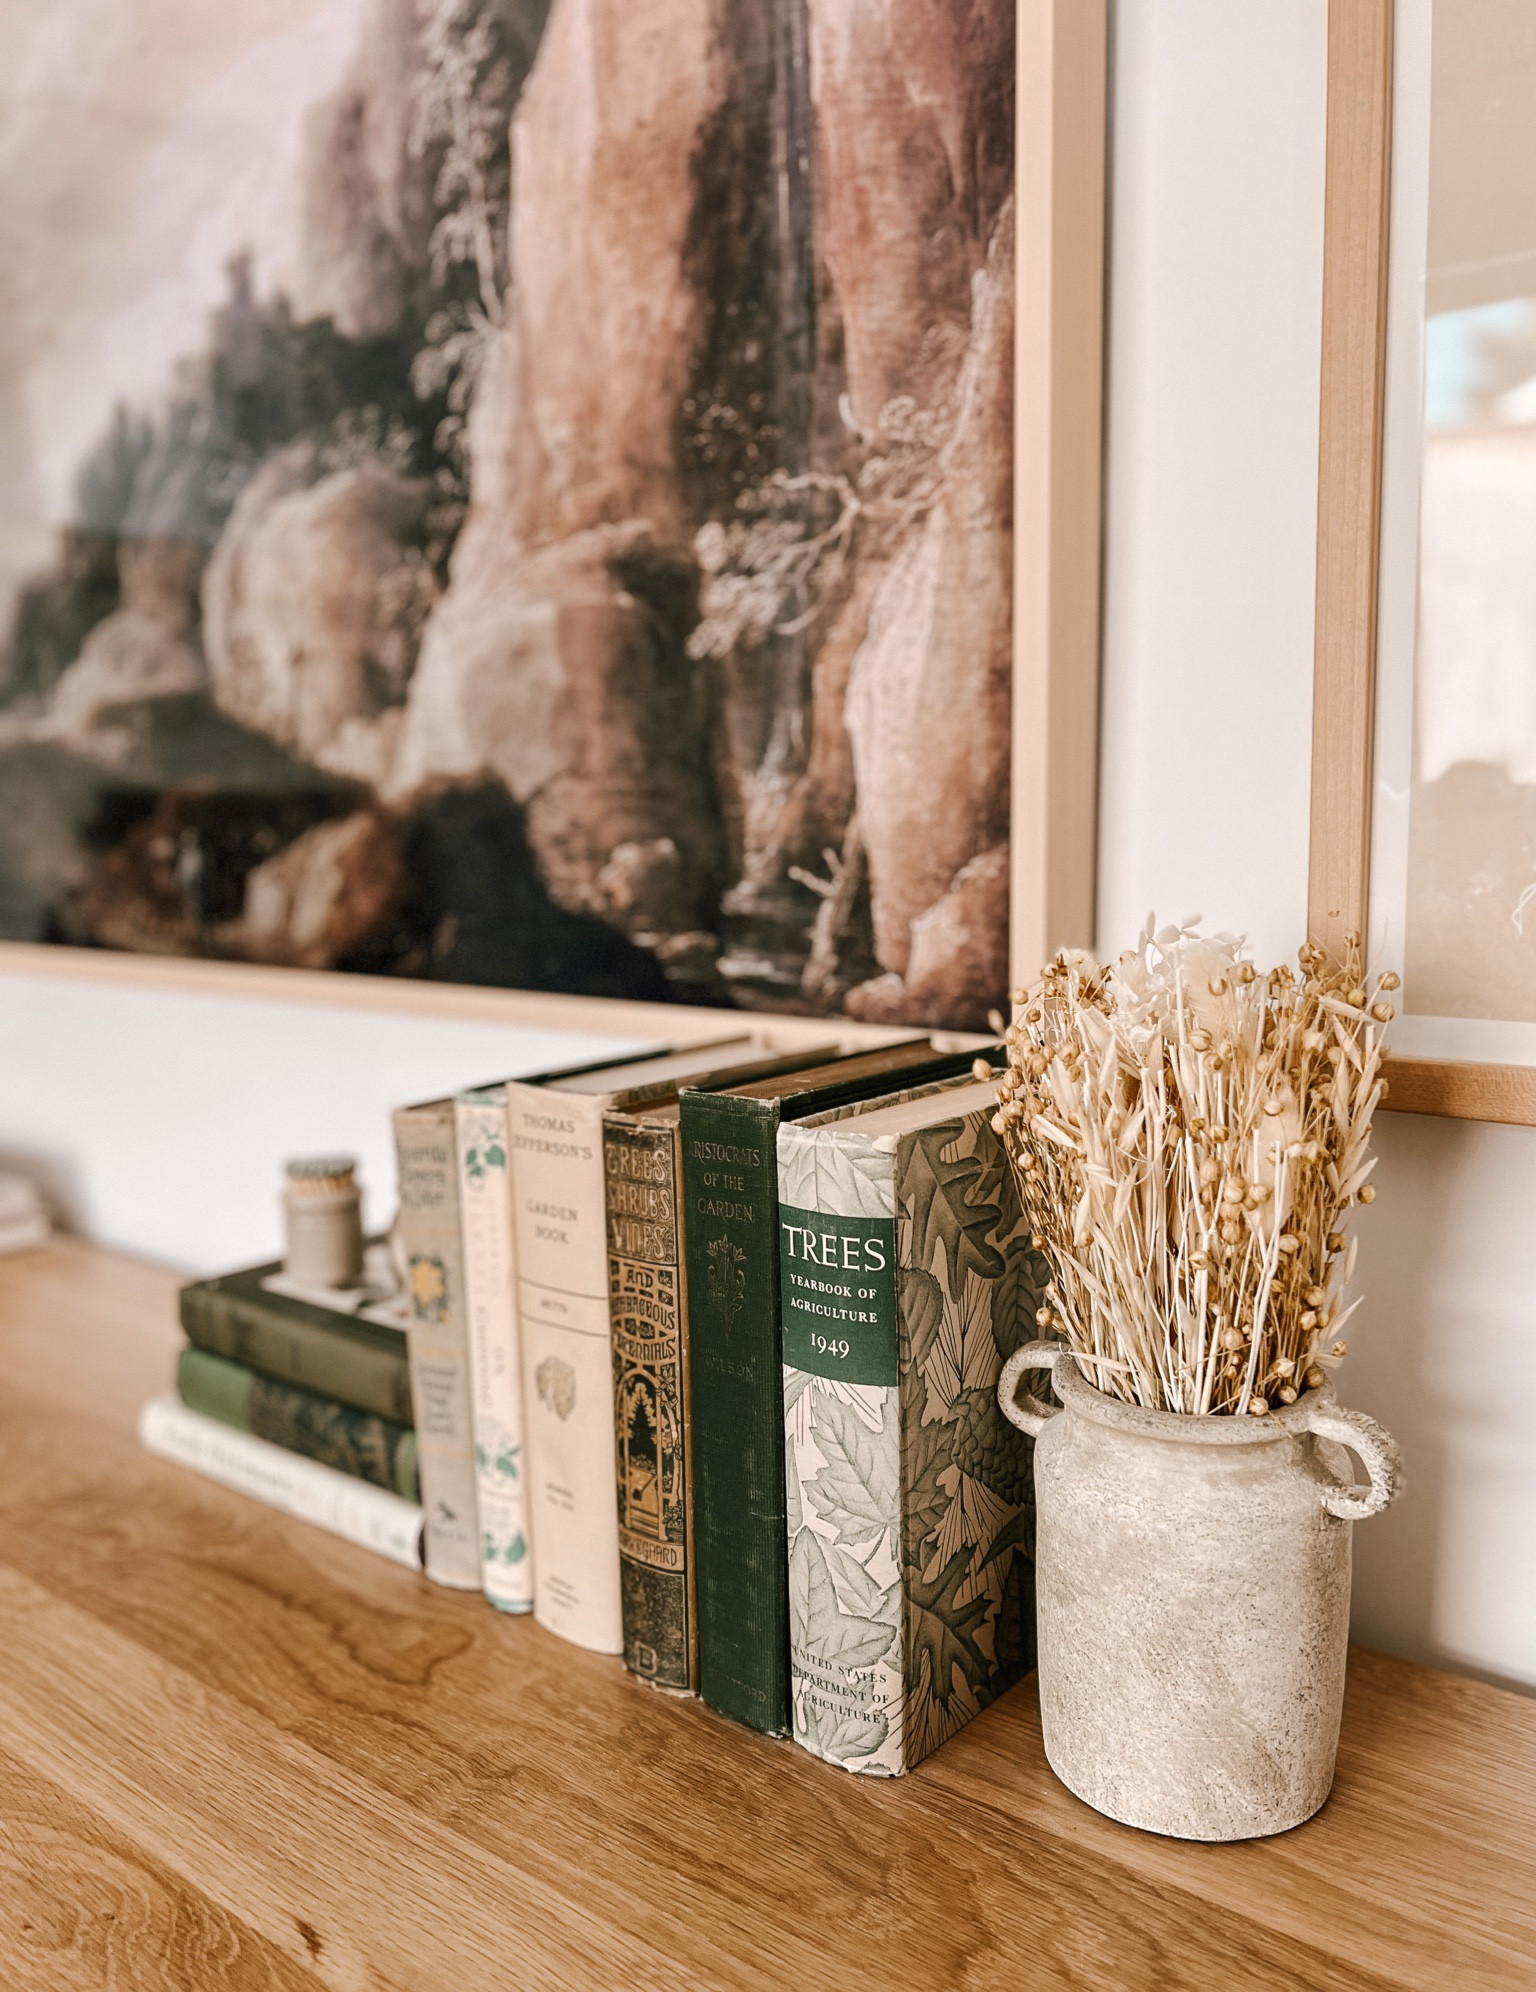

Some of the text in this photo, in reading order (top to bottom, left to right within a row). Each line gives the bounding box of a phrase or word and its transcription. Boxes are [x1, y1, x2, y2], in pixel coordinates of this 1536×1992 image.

[522, 1112, 575, 1134] THOMAS
[605, 1144, 668, 1183] TREES
[703, 1171, 745, 1191] OF THE
[526, 1198, 578, 1222] GARDEN
[607, 1179, 671, 1220] SHRUBS
[697, 1198, 753, 1222] GARDEN
[534, 1224, 569, 1245] BOOK
[611, 1218, 667, 1260] VINES
[782, 1221, 886, 1272] TREES
[626, 1269, 654, 1289] AND
[790, 1273, 878, 1300] YEARBOOK OF
[790, 1296, 878, 1324] AGRICULTURE
[810, 1332, 850, 1359] 1949
[792, 1663, 889, 1704] DEPARTMENT OF
[838, 1666, 887, 1683] STATES
[799, 1689, 881, 1724] AGRICULTURE
